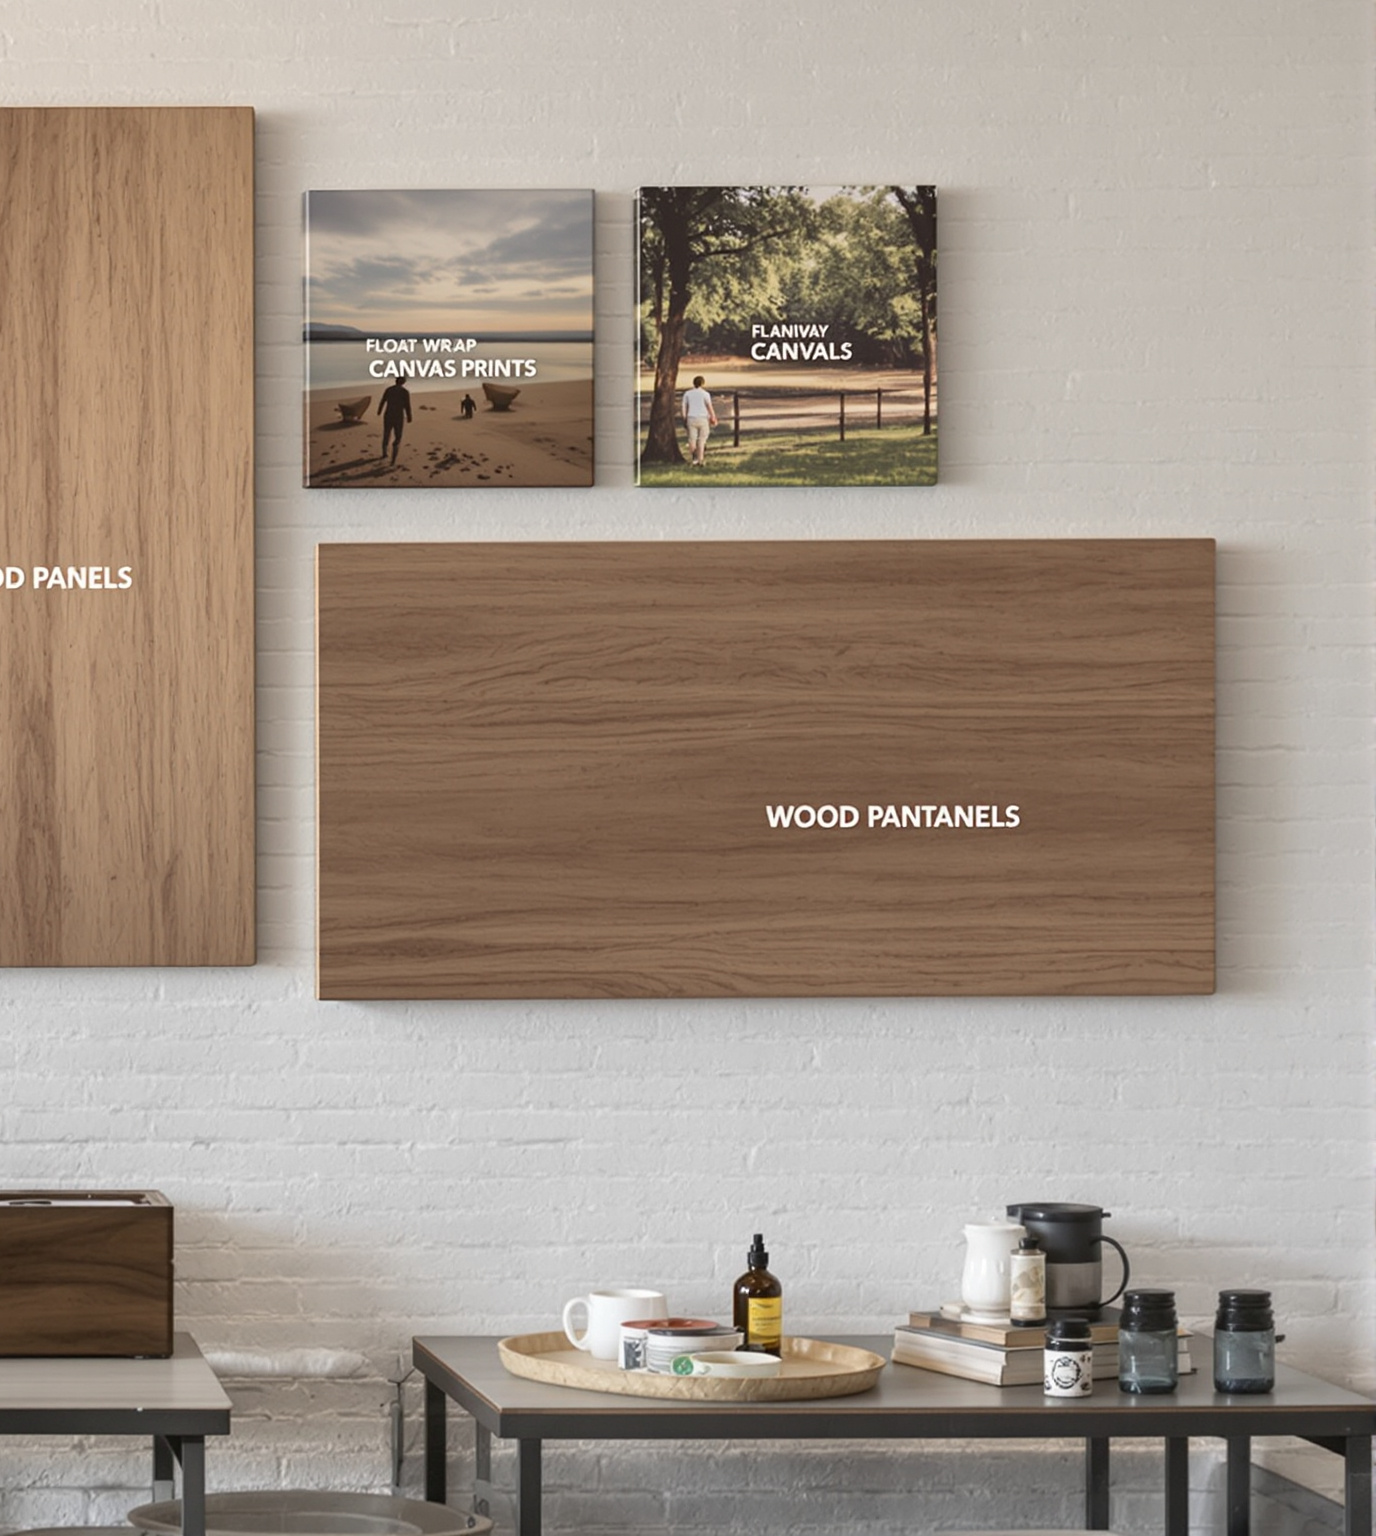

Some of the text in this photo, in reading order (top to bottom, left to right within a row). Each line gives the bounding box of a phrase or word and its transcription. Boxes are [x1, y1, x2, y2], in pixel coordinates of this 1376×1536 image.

[751, 324, 829, 338] FLANIVAY
[366, 338, 477, 353] FLOAT WRAP
[750, 341, 853, 361] CANVALS
[369, 358, 537, 378] CANVAS PRINTS
[33, 566, 132, 590] PANELS
[765, 804, 1021, 828] WOOD PANTANELS
